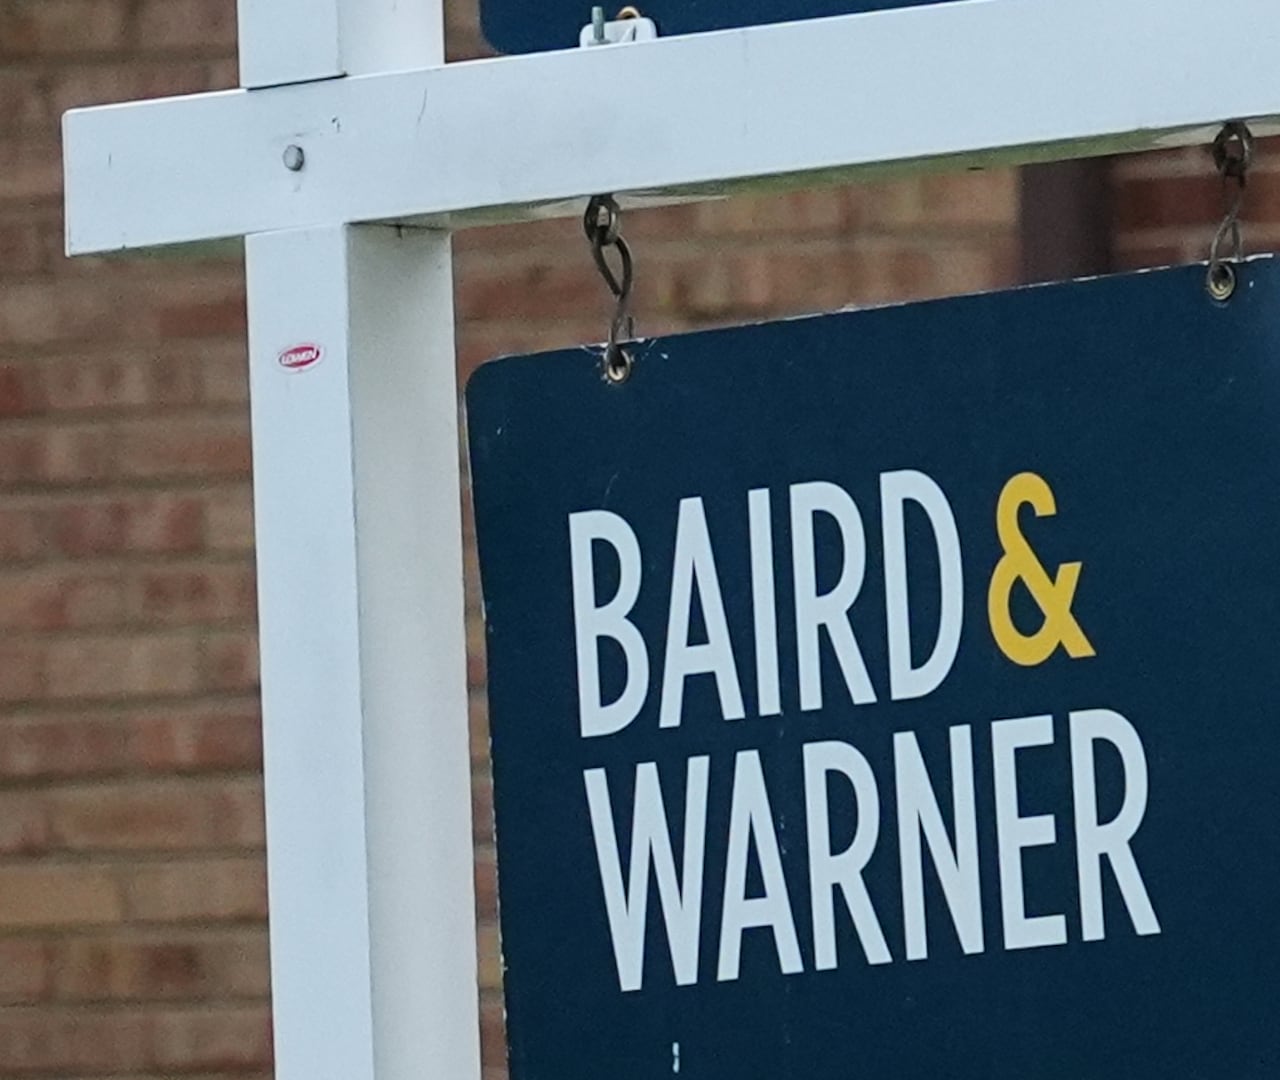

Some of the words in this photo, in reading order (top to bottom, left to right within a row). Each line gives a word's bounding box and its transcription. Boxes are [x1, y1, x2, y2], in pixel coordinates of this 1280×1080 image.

[569, 469, 964, 739] BAIRD
[987, 471, 1096, 667] &
[583, 708, 1161, 993] WARNER
